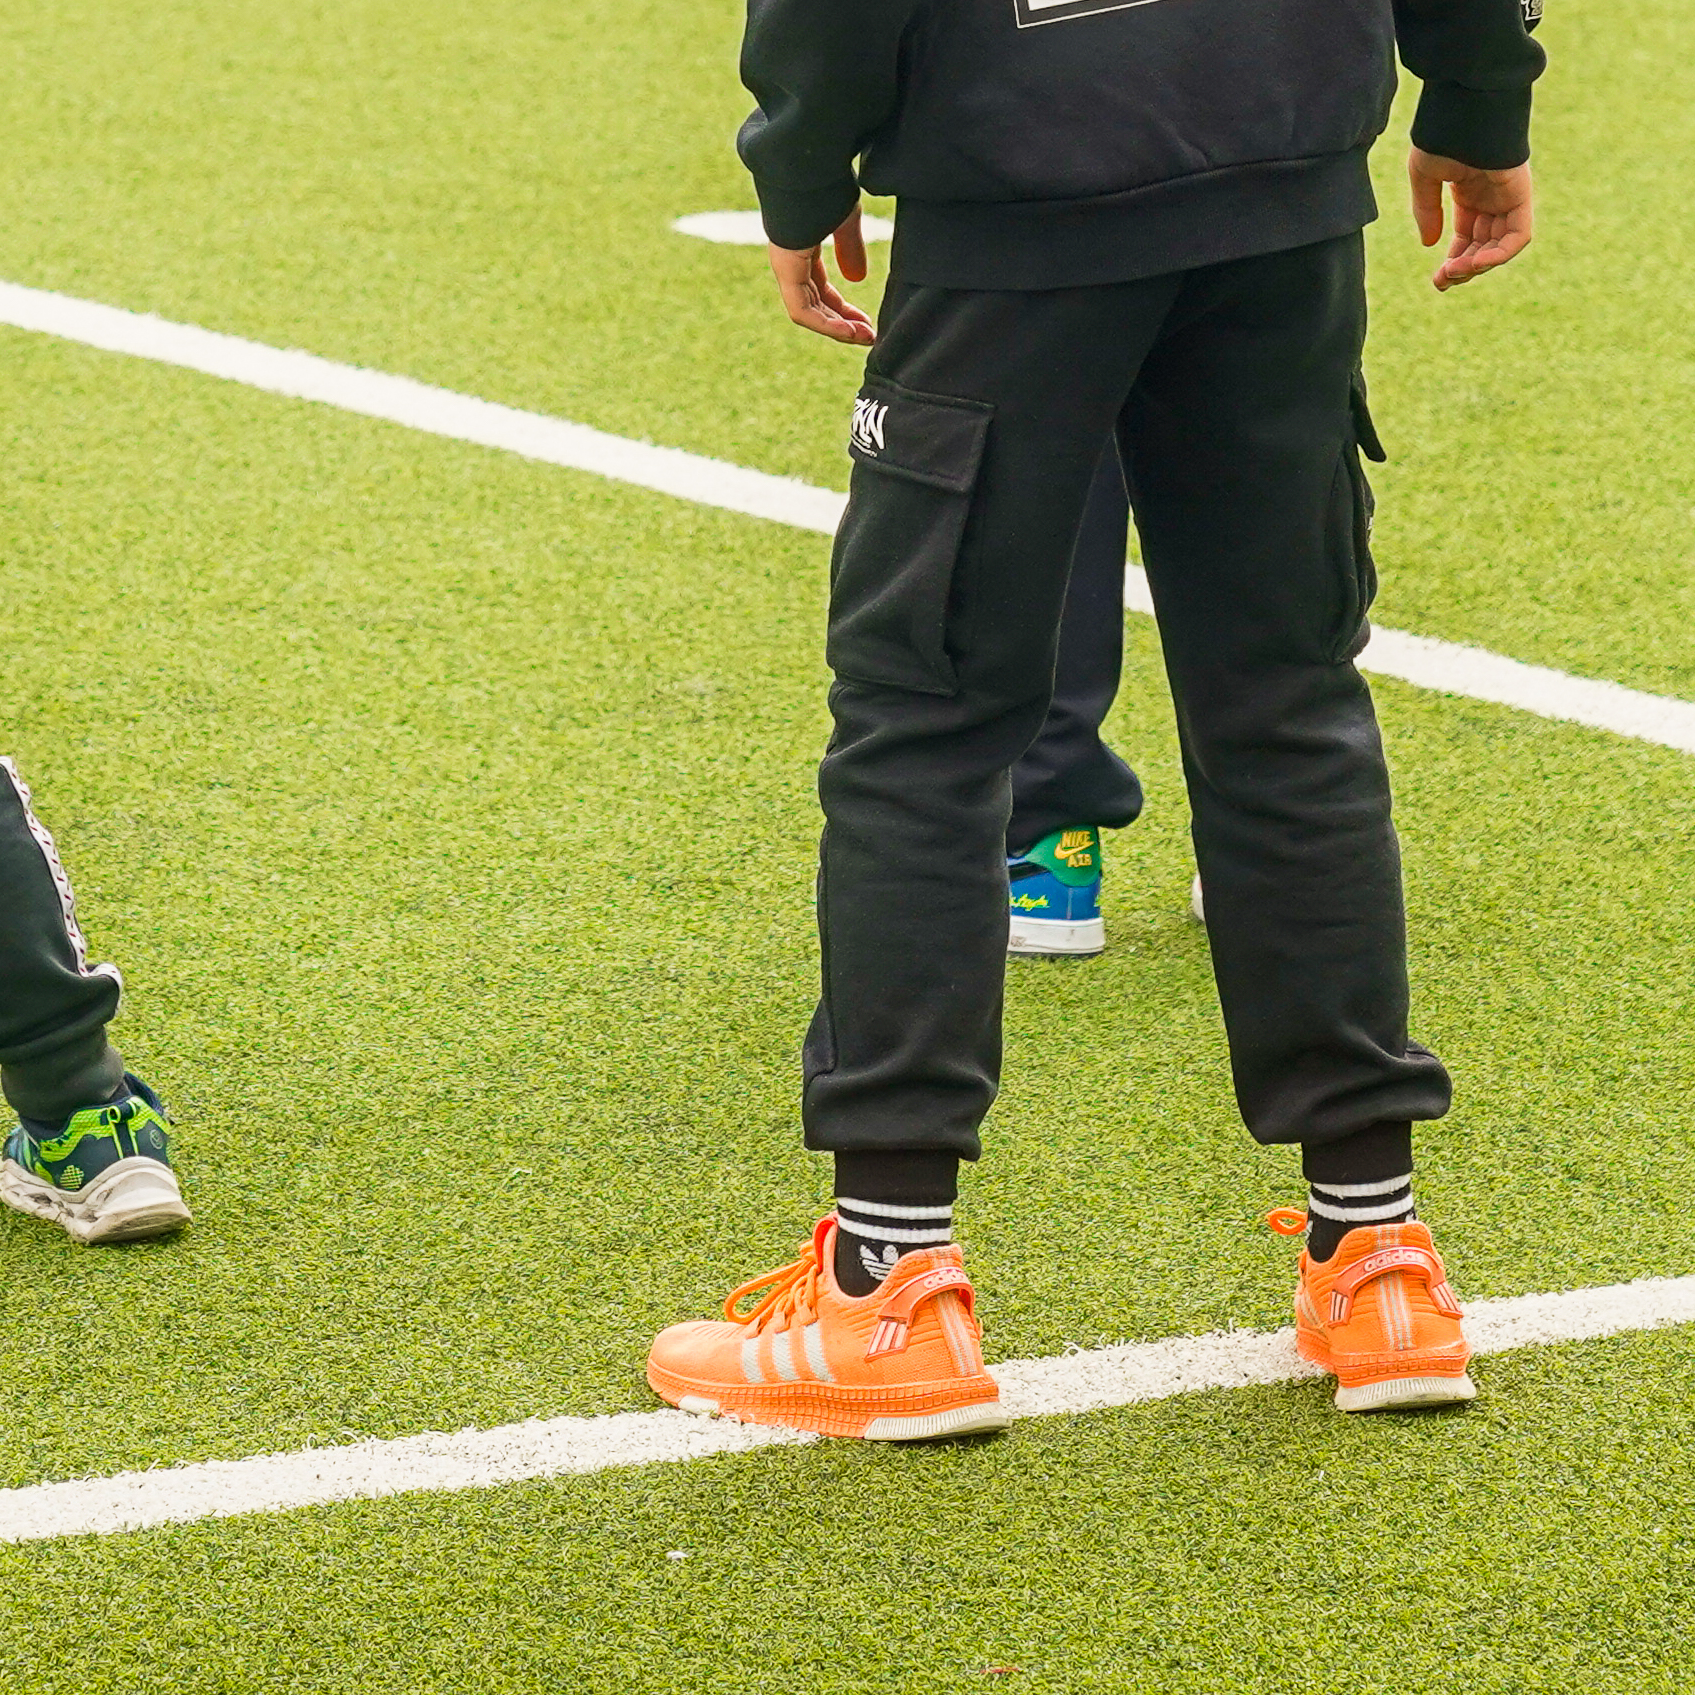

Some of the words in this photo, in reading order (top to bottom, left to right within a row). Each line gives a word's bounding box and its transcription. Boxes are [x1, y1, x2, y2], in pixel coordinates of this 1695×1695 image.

[1061, 830, 1091, 848] NIKE
[1067, 853, 1092, 868] AIR
[1364, 1249, 1426, 1272] adidas
